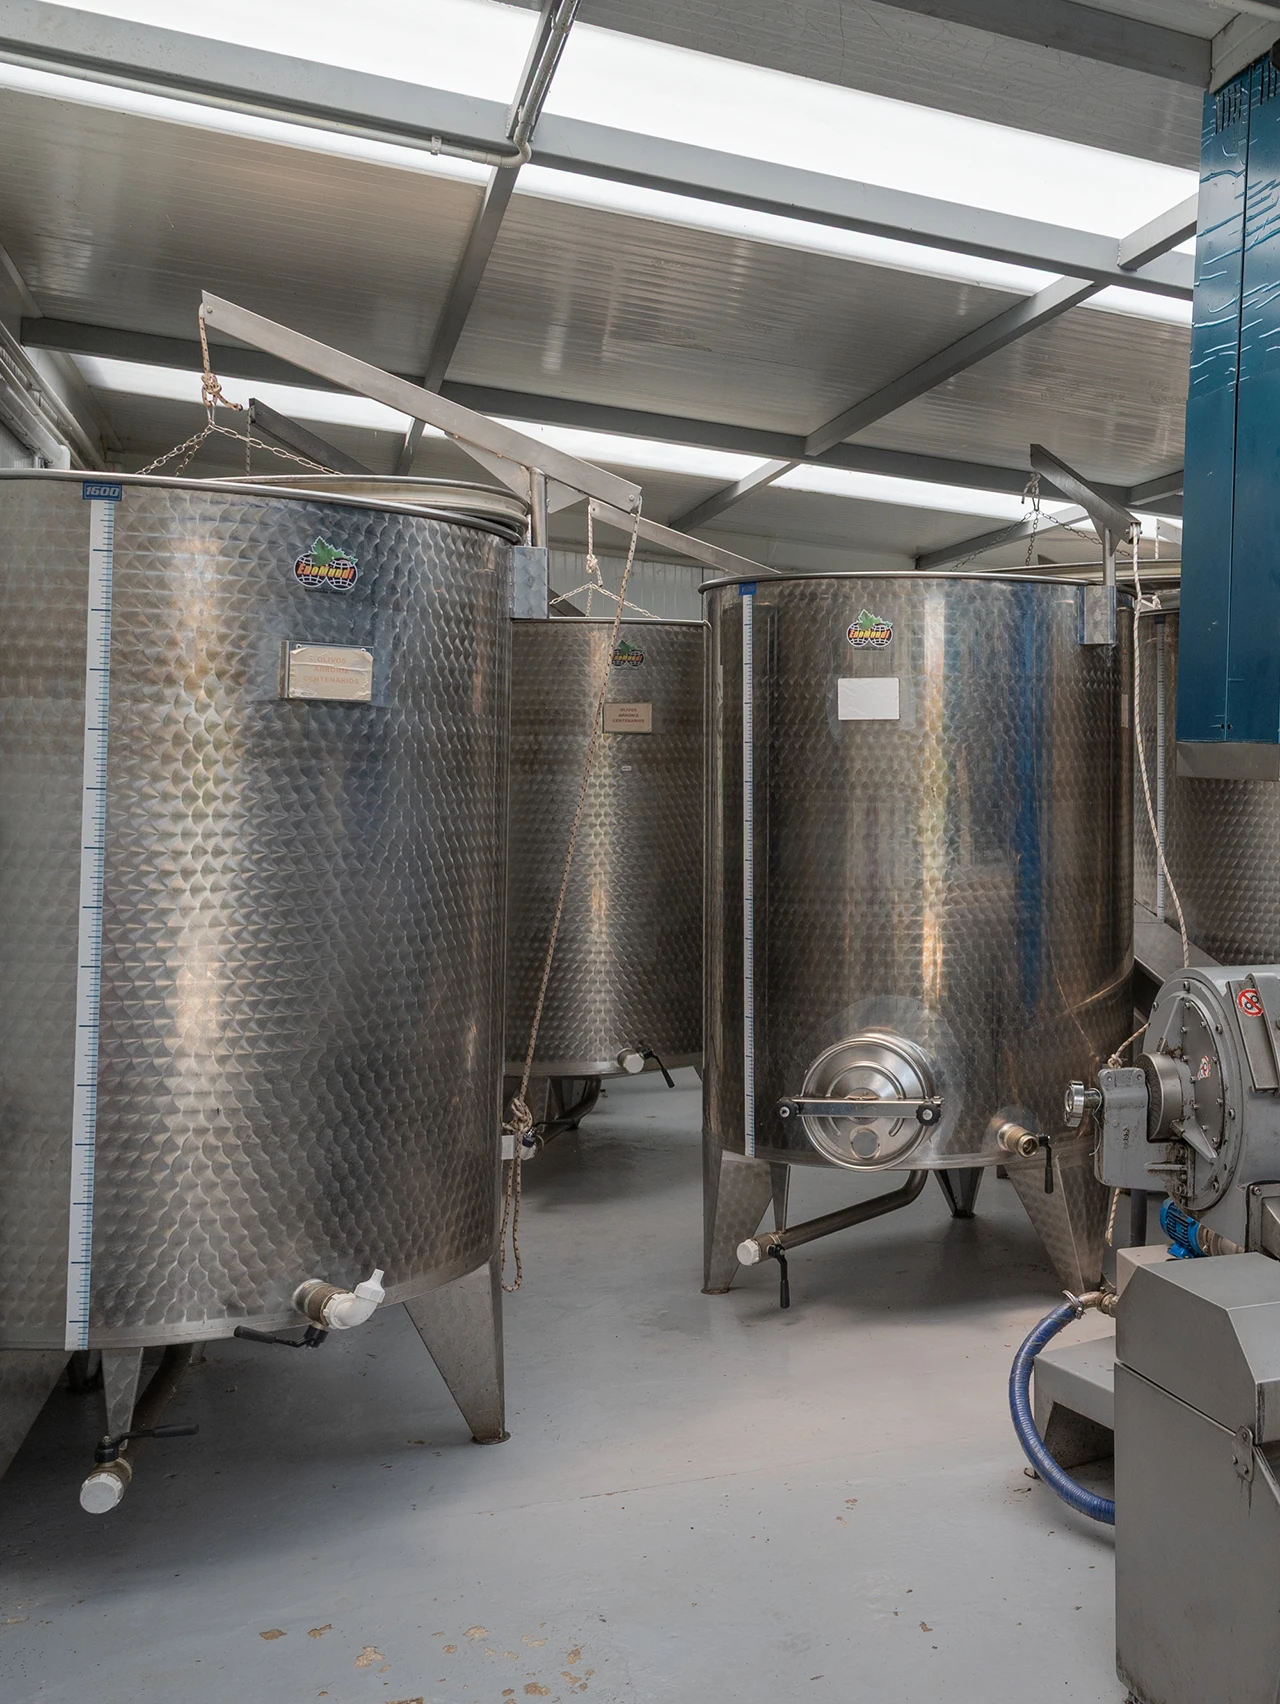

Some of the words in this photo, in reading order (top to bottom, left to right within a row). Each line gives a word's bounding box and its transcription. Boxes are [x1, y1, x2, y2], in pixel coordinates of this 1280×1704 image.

[86, 486, 120, 496] 1600
[296, 563, 355, 580] EnoMundi
[848, 630, 890, 639] EnoMundi
[314, 666, 348, 674] ARRONIZ
[303, 675, 359, 684] CENTENARIOS
